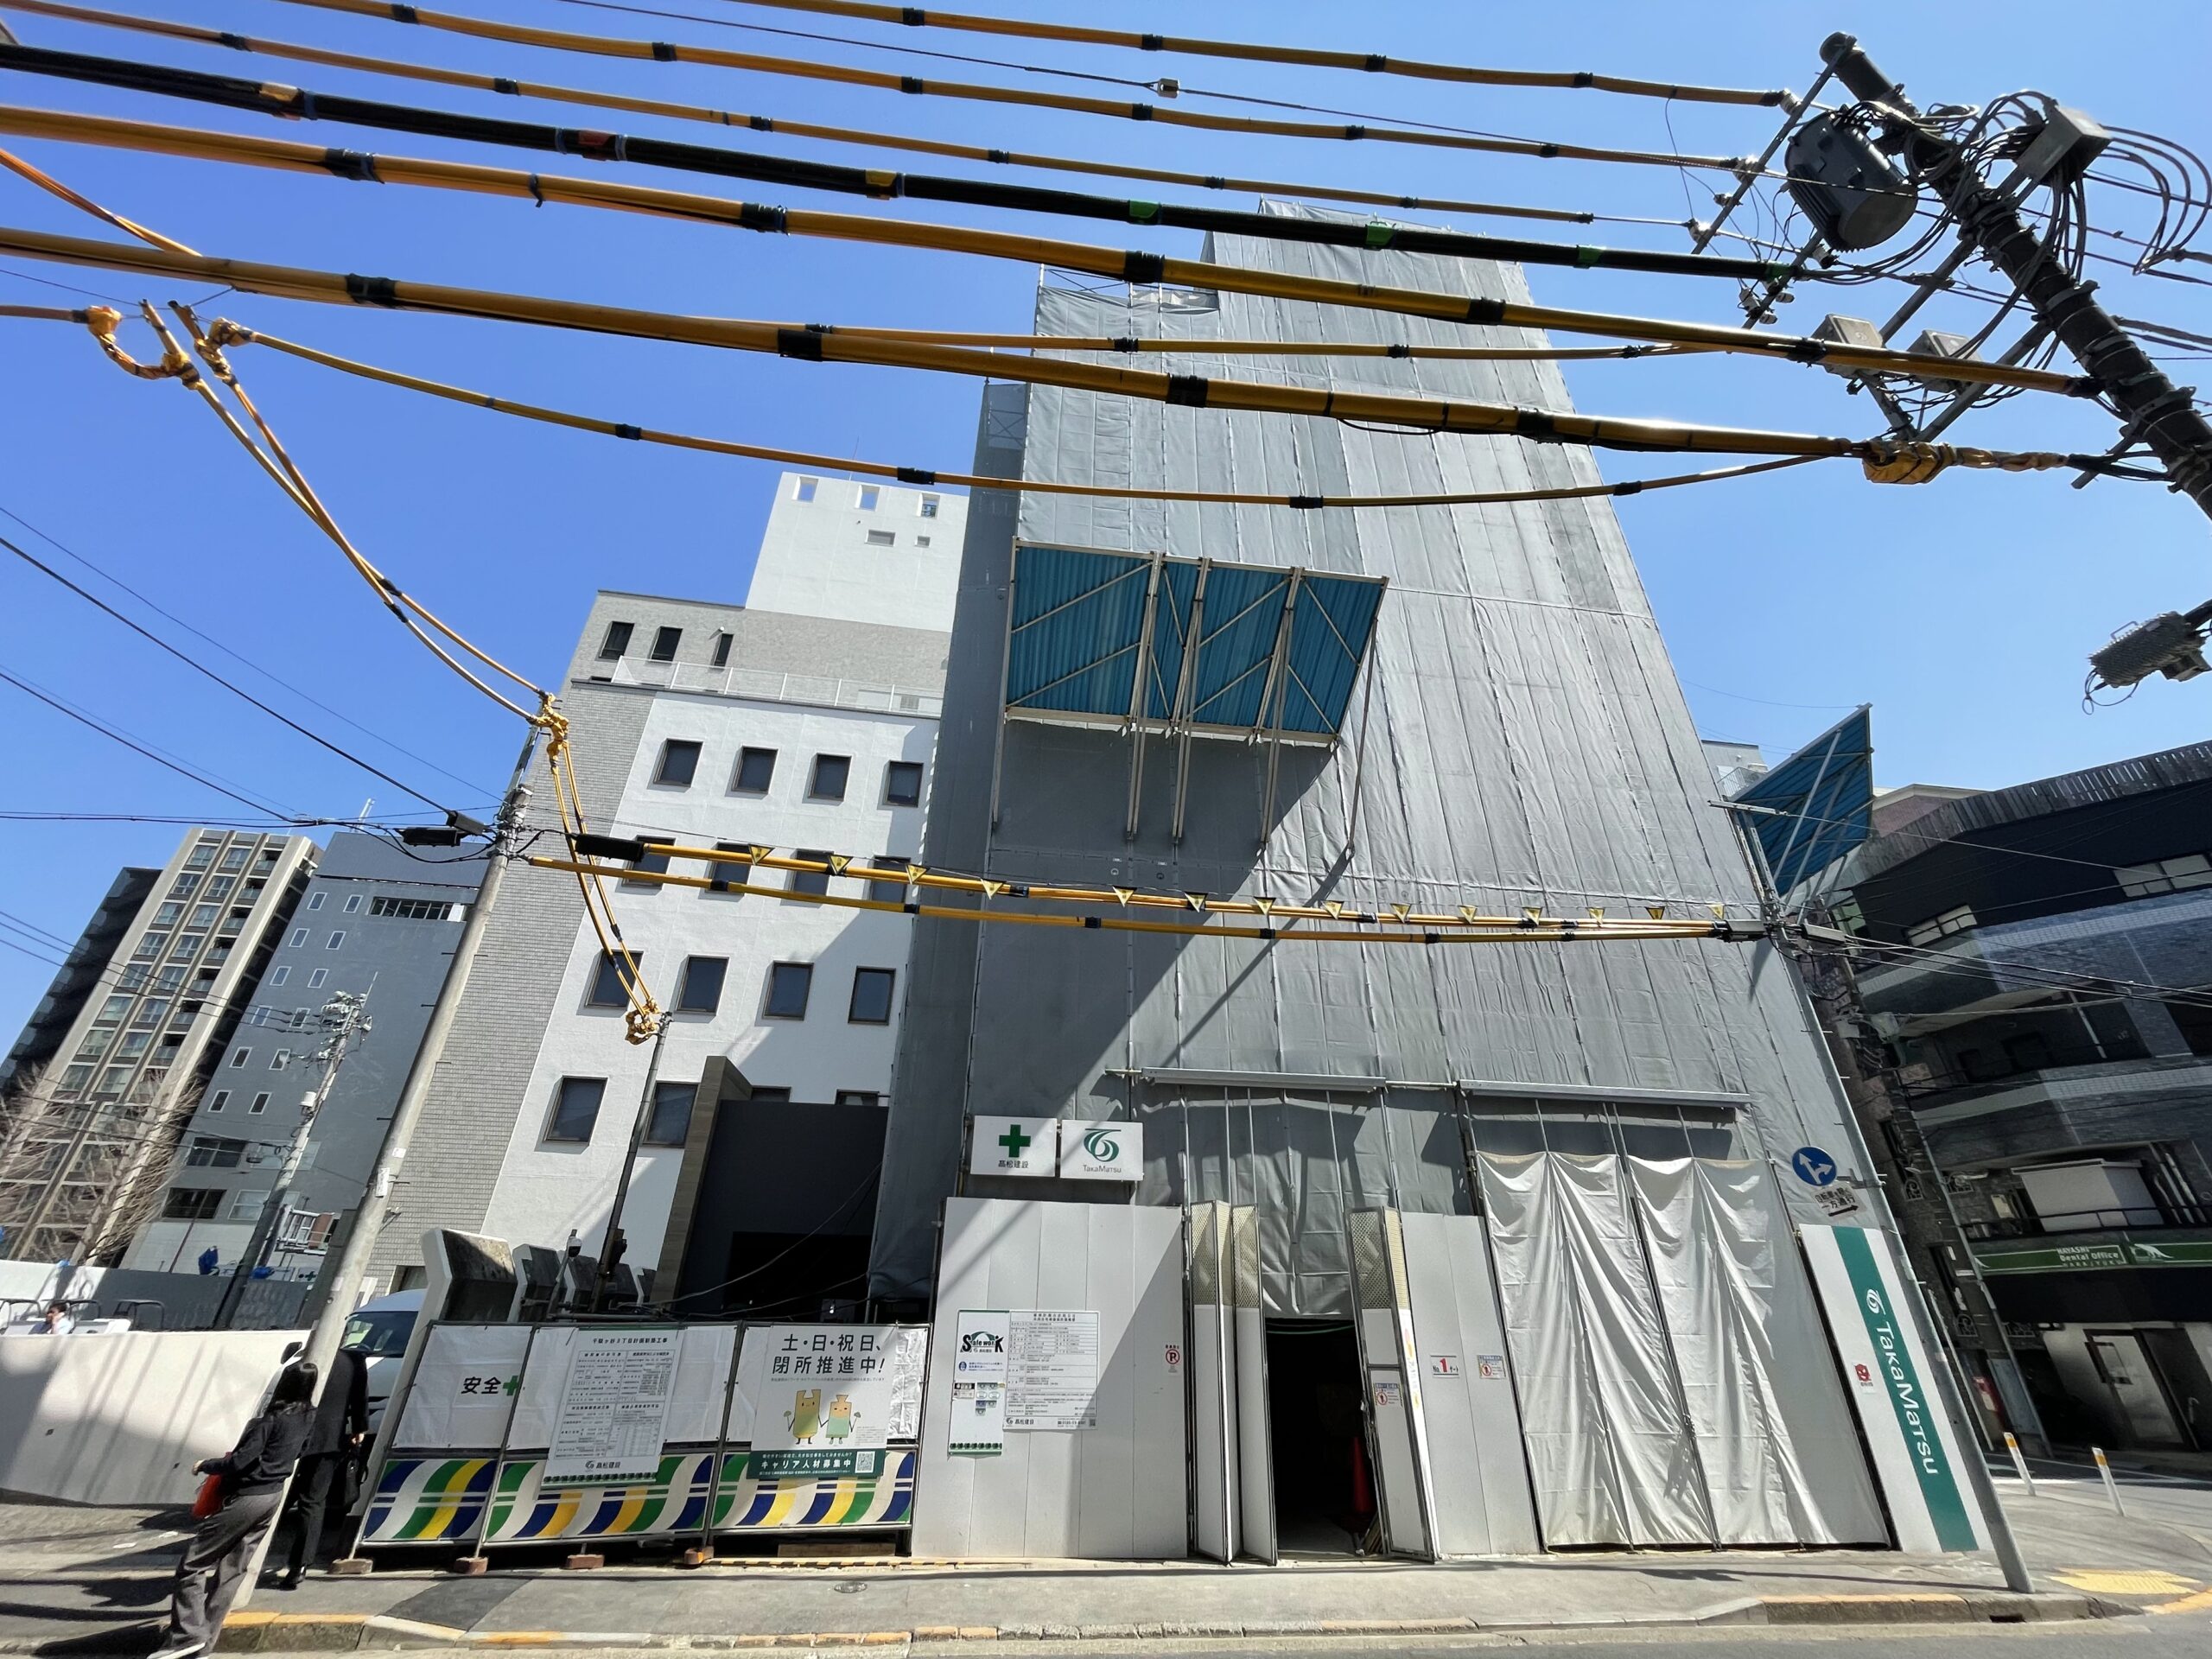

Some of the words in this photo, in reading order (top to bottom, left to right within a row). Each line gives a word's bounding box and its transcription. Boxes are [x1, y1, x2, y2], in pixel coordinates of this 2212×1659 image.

[2060, 1253, 2089, 1262] Dental
[2092, 1251, 2119, 1260] Office
[461, 1376, 501, 1394] 安全
[1877, 1321, 1938, 1474] TakaMatsu
